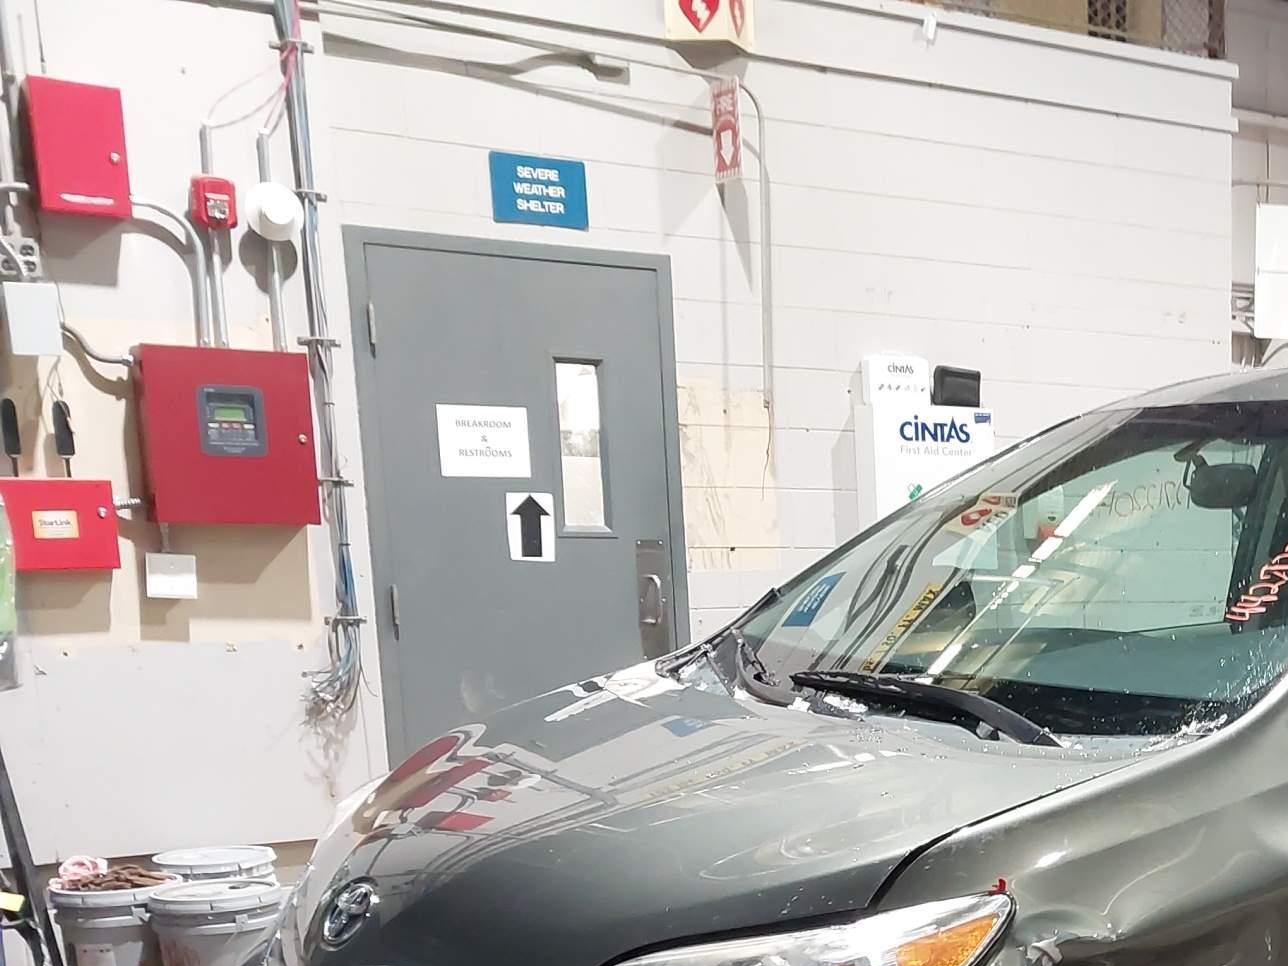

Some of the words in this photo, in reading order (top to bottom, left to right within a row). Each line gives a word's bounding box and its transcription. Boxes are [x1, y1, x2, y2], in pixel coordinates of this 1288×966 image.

[715, 94, 735, 115] FIRE
[516, 165, 560, 182] SEVERE
[513, 182, 566, 198] WEATHER
[516, 198, 565, 215] SHELTER
[456, 419, 512, 429] BREAKROOM
[481, 434, 488, 443] &
[459, 448, 512, 458] RESTROOMS
[901, 446, 921, 456] First
[924, 447, 940, 457] Aid
[943, 447, 972, 458] Center
